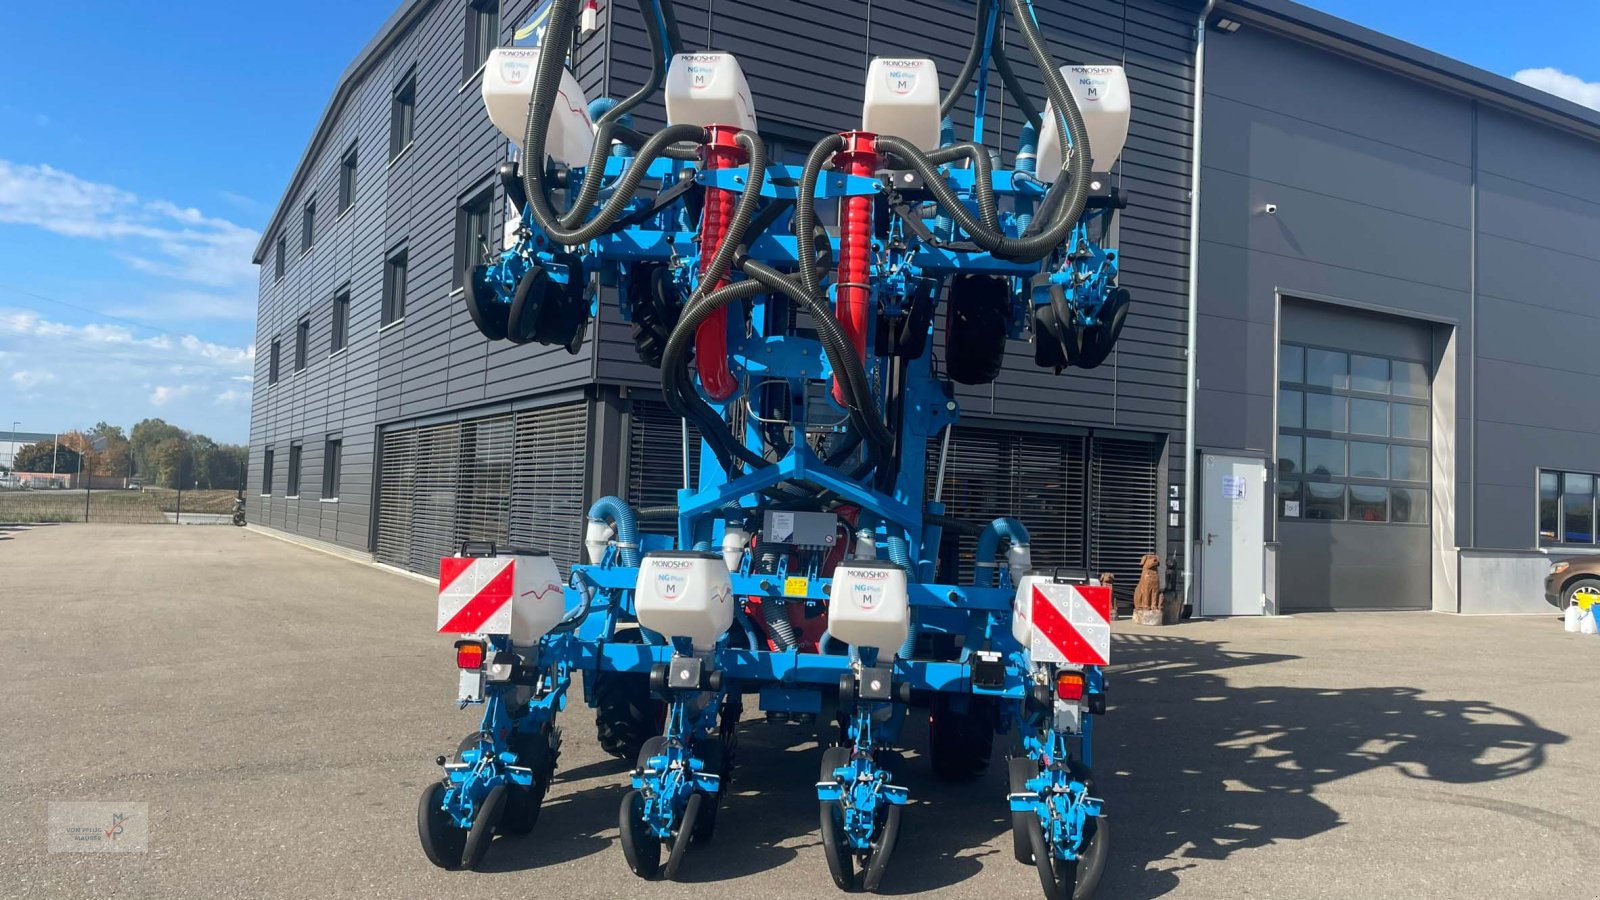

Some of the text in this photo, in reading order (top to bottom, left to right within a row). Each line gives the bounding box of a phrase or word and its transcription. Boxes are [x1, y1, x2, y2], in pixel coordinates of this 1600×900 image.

[511, 70, 520, 79] M
[695, 75, 704, 84] M
[897, 80, 907, 89] M
[1088, 87, 1097, 96] M
[658, 573, 669, 581] NG
[666, 584, 676, 593] M
[862, 594, 872, 603] M
